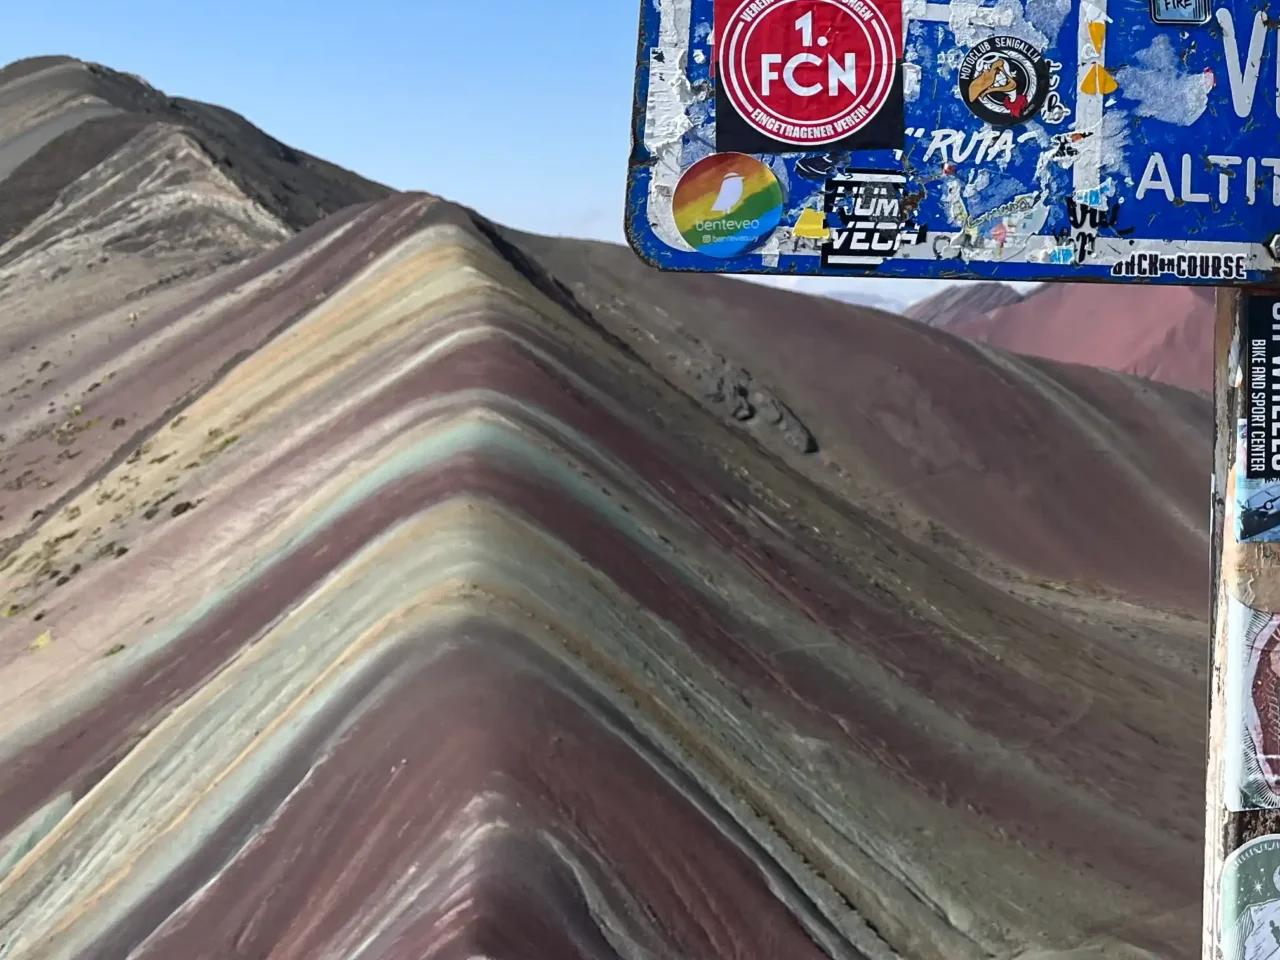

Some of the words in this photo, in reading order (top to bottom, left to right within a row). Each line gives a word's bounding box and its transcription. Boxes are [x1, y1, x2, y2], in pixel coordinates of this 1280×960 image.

[795, 10, 828, 47] 1.
[761, 52, 857, 97] FCN
[960, 42, 991, 80] MOTOCLUB
[994, 36, 1041, 63] SENIGALLIA
[751, 108, 835, 138] EINGETRAGENER
[836, 105, 870, 132] VEREIN
[695, 219, 760, 232] benteveo
[1176, 254, 1245, 278] COURSE
[1251, 339, 1266, 364] BIKE
[1251, 366, 1266, 389] AND
[1251, 391, 1266, 429] SPORT
[1250, 432, 1265, 472] CENTER
